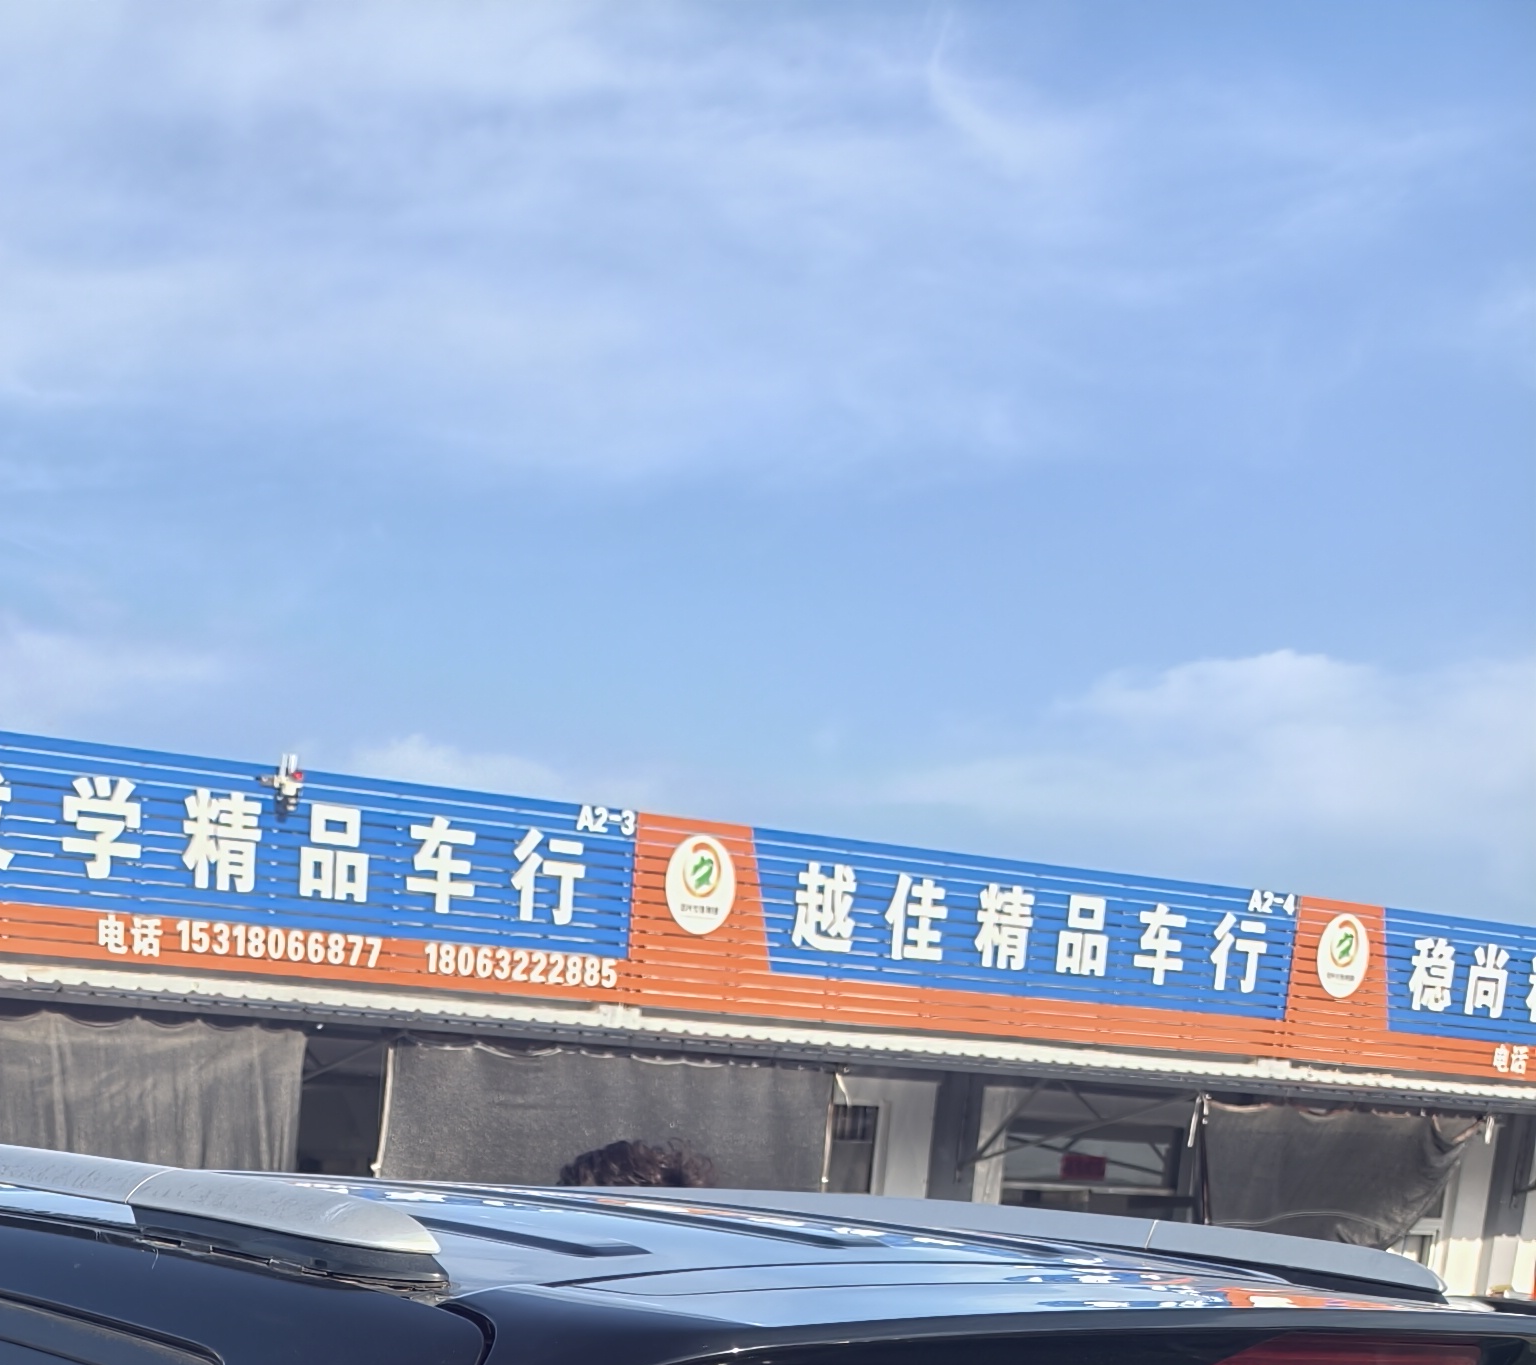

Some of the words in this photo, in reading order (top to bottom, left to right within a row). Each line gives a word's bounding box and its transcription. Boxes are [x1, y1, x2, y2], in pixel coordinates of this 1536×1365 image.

[577, 805, 636, 836] A2-3
[791, 862, 1267, 993] 越佳精品车行
[1248, 889, 1295, 915] A2-4
[98, 914, 163, 957] 电话
[176, 919, 383, 968] 15318066877
[424, 943, 618, 989] 18063222885
[1408, 937, 1536, 1023] 稳尚
[1492, 1044, 1529, 1074] 电话
